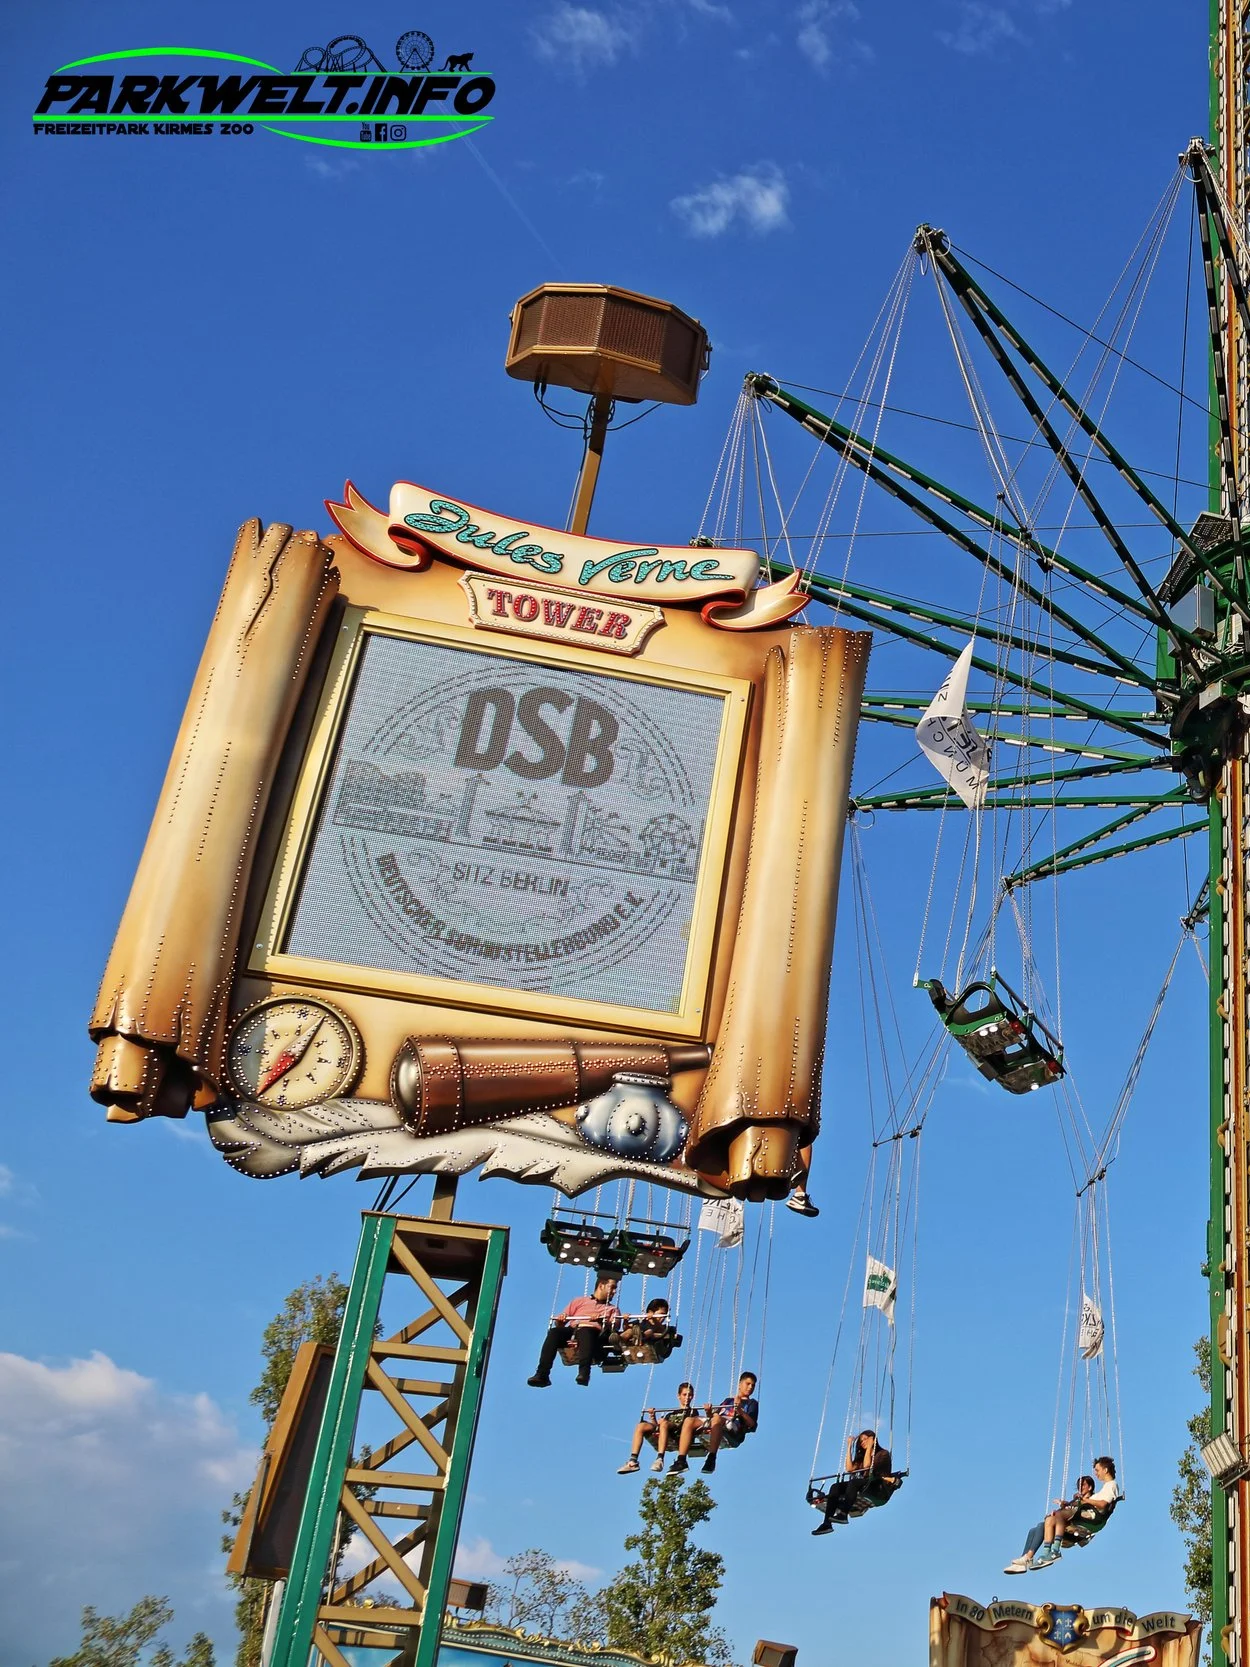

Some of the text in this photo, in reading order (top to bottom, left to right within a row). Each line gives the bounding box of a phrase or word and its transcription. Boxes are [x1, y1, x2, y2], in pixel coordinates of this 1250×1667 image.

[404, 499, 736, 585] Jules Verne
[487, 588, 633, 639] TOWER
[454, 686, 621, 788] DSB
[452, 862, 571, 897] SITZ BERLIN
[955, 1601, 1177, 1633] In 80 Metern um die Welt
